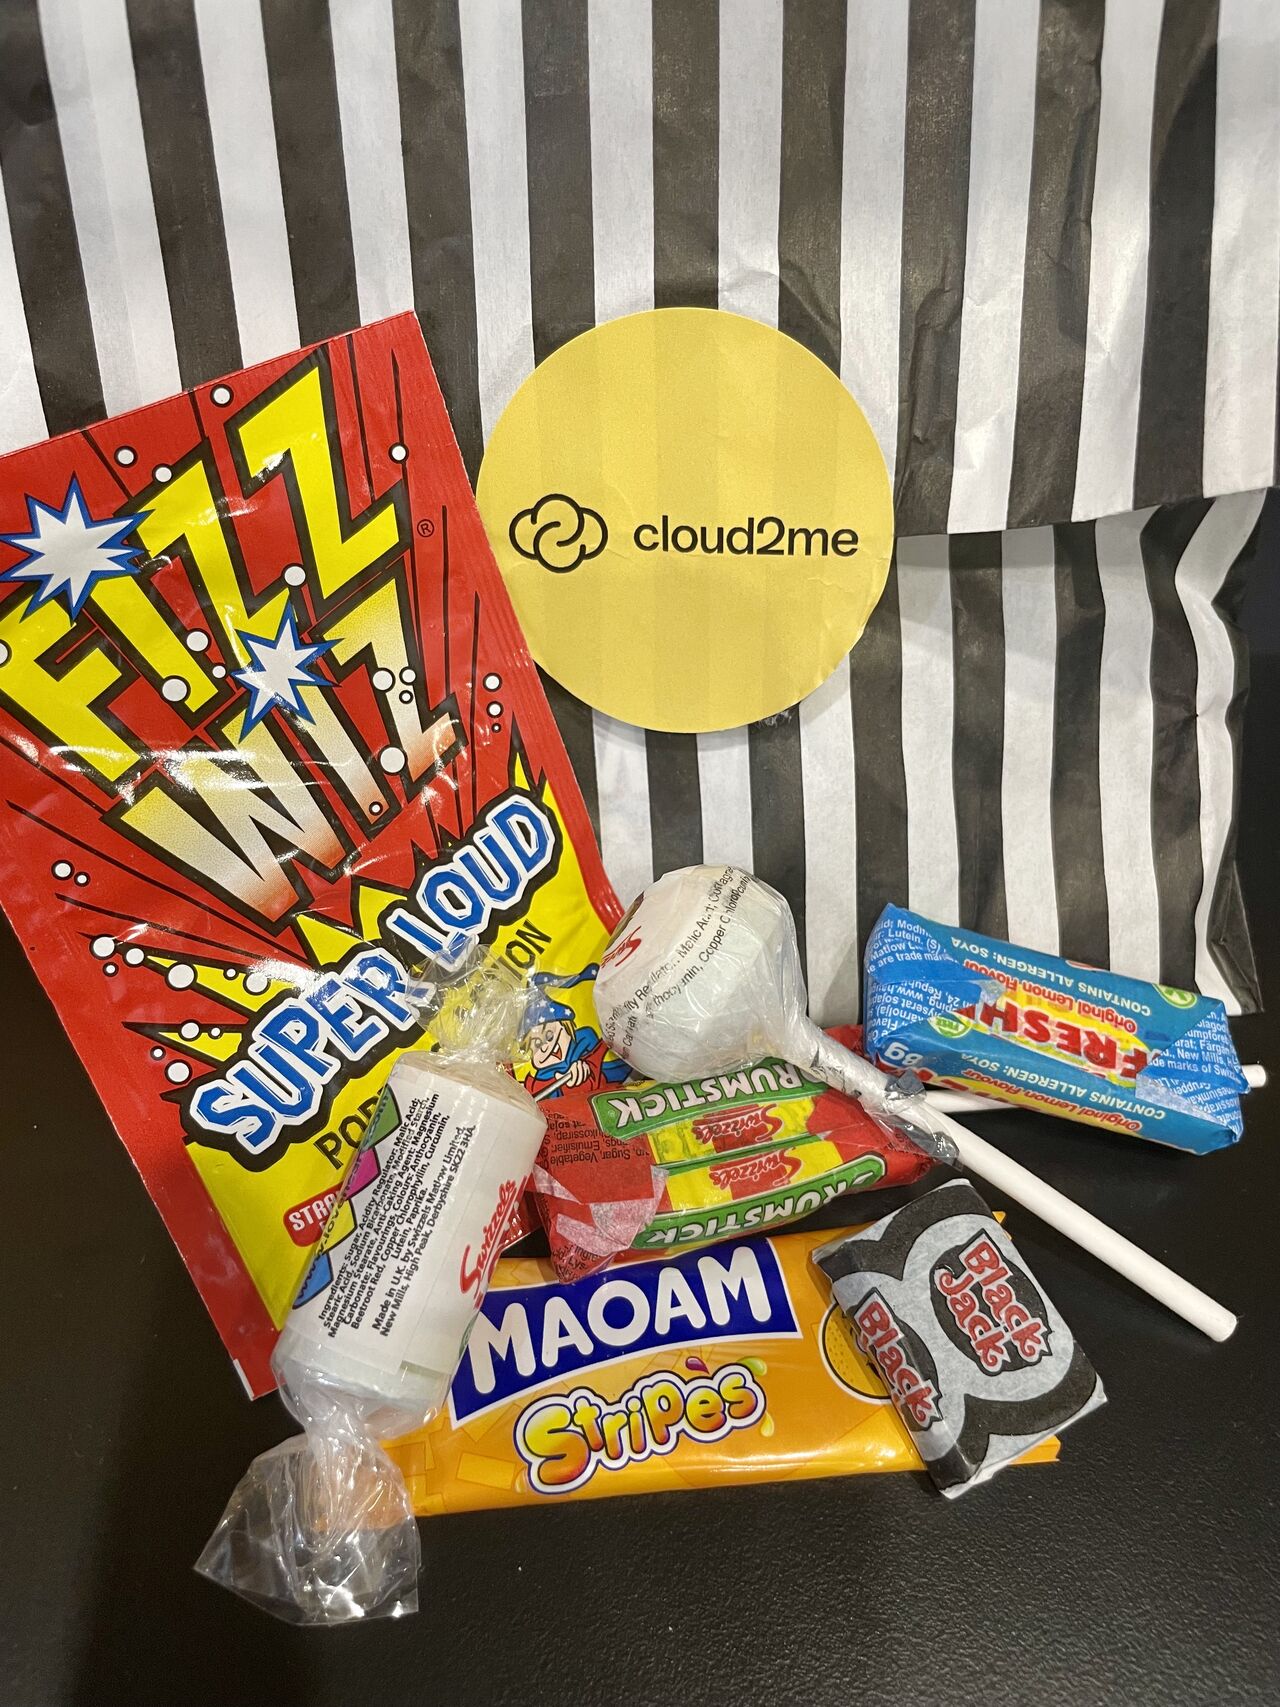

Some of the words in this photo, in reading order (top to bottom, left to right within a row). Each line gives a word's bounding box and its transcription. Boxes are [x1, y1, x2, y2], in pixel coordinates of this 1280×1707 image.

[633, 514, 859, 557] cloud2me
[0, 364, 401, 784] FIZZ
[119, 577, 457, 922] WIZ
[675, 928, 702, 958] Malic
[697, 924, 726, 962] Copper
[895, 948, 922, 963] trade
[948, 935, 989, 958] SOYA
[191, 948, 432, 1154] SUPER
[387, 794, 556, 970] LOUD
[989, 949, 1075, 990] ALLERGEN:
[1018, 978, 1076, 1011] Lemon
[1073, 996, 1140, 1034] Original
[1074, 980, 1153, 1018] CONTAINS
[884, 1041, 924, 1066] 8g
[958, 1052, 1000, 1072] SOYA
[1166, 1060, 1198, 1072] marks
[1201, 1063, 1211, 1072] of
[1176, 1048, 1200, 1061] New
[960, 1067, 1022, 1095] Flavour
[1001, 1064, 1087, 1099] ALLERGEN:
[1022, 1086, 1077, 1113] Lemon
[1080, 1103, 1142, 1134] Original
[1088, 1089, 1166, 1122] CONTAINS
[691, 1103, 783, 1150] Swizzels
[549, 1149, 598, 1168] Vegetable
[599, 1149, 630, 1160] Sugar,
[708, 1145, 803, 1191] Swizzels
[425, 1163, 448, 1204] Matlow
[649, 1163, 879, 1245] RUMSTICK
[317, 1261, 349, 1321] Ingredients:
[343, 1230, 363, 1262] Sugar,
[357, 1196, 378, 1230] Acidity
[371, 1147, 399, 1197] Regulator:
[393, 1120, 409, 1147] Malic
[322, 1293, 343, 1328] Stearic
[337, 1267, 355, 1294] Acid,
[349, 1229, 370, 1267] Sodium
[391, 1127, 415, 1170] Modified
[327, 1279, 359, 1339] Magnesium
[352, 1235, 378, 1280] Stearate,
[371, 1178, 403, 1236] Anti-Caking
[396, 1145, 417, 1179] Agent:
[410, 1091, 441, 1146] Magnesium
[342, 1270, 372, 1325] Carbonate;
[365, 1210, 399, 1271] Flavourings,
[391, 1171, 414, 1211] Colours:
[408, 1109, 443, 1172] Anthocyanin,
[350, 1284, 376, 1330] Beetroot
[369, 1261, 386, 1285] Red,
[379, 1225, 402, 1263] Copper
[395, 1159, 431, 1226] Chlorophyllin,
[423, 1112, 450, 1160] Curcumin,
[379, 1310, 397, 1337] New
[391, 1281, 410, 1310] Mills,
[403, 1255, 422, 1282] High
[414, 1227, 433, 1256] Peak,
[426, 1173, 456, 1228] Derbyshire
[449, 1147, 465, 1173] SK22
[460, 1122, 476, 1147] 3HA.
[390, 1224, 412, 1260] Lutein,
[405, 1185, 429, 1225] Paprika.
[407, 1204, 431, 1248] Swizzels
[400, 1247, 415, 1264] by
[460, 1179, 520, 1297] Swizzels
[386, 1286, 396, 1298] in
[391, 1262, 406, 1286] U.K.
[372, 1298, 391, 1330] Made
[962, 1239, 1047, 1358] Black
[465, 1246, 772, 1395] MAOAM
[938, 1271, 1007, 1369] Jack
[856, 1300, 935, 1424] Black
[515, 1364, 766, 1493] Stripes
